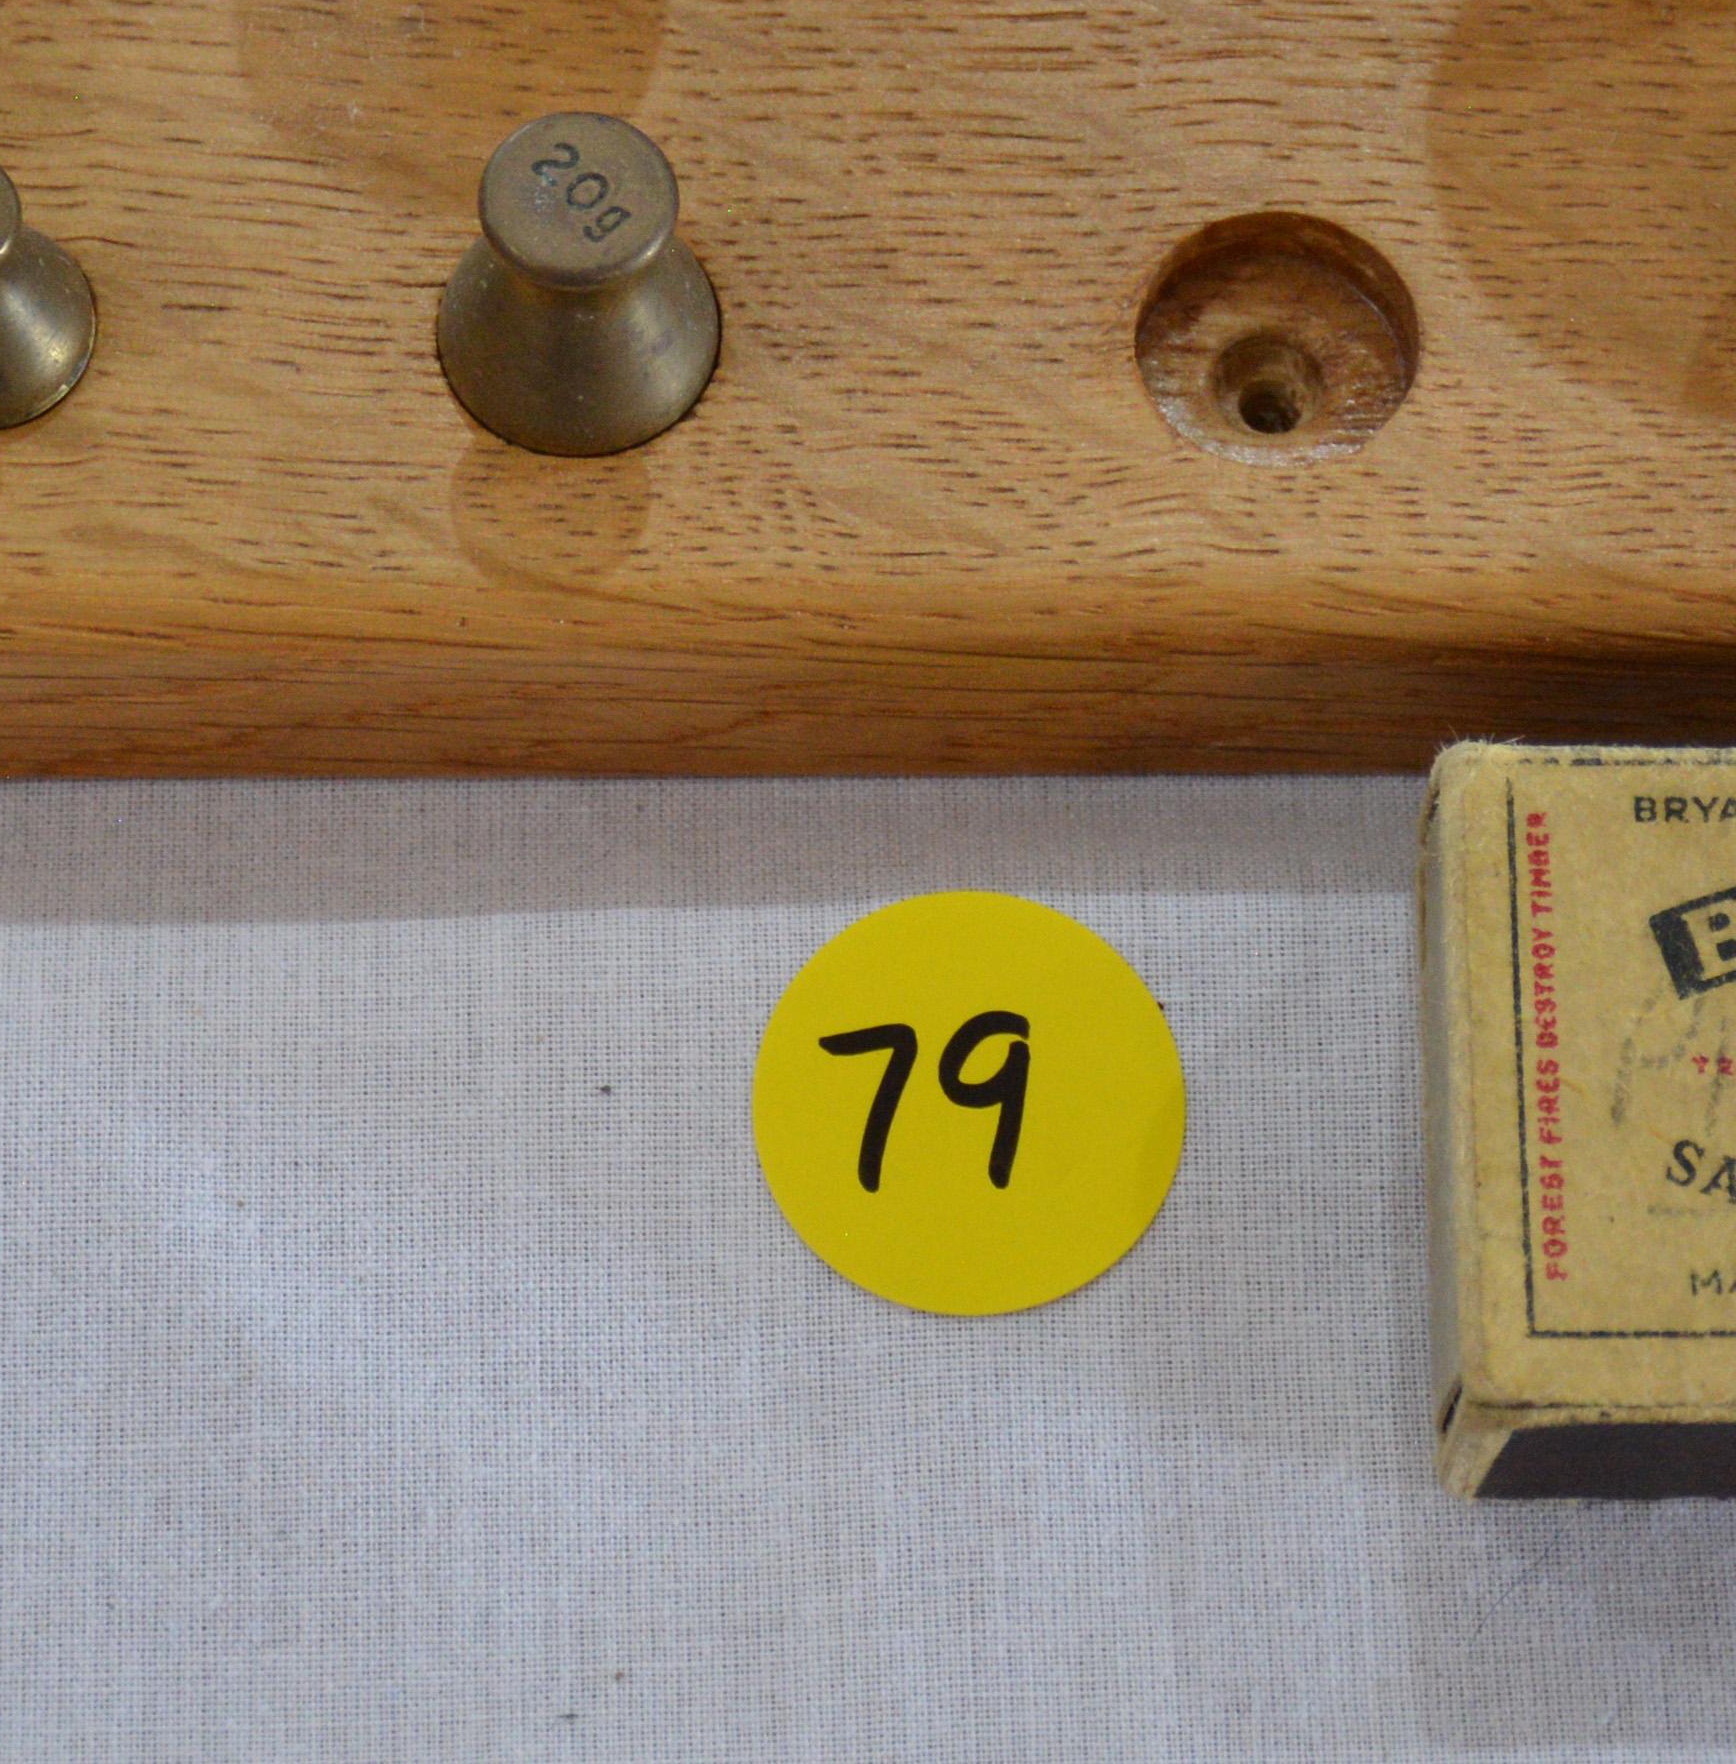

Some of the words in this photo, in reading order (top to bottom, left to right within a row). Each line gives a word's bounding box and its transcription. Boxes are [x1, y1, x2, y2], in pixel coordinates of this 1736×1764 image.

[530, 141, 632, 244] 20g
[1525, 810, 1555, 917] TIMBER
[1530, 927, 1559, 1049] DESTROY
[817, 1009, 1032, 1194] 79
[1535, 1057, 1563, 1145] FIRES
[1538, 1154, 1568, 1282] FOREST
